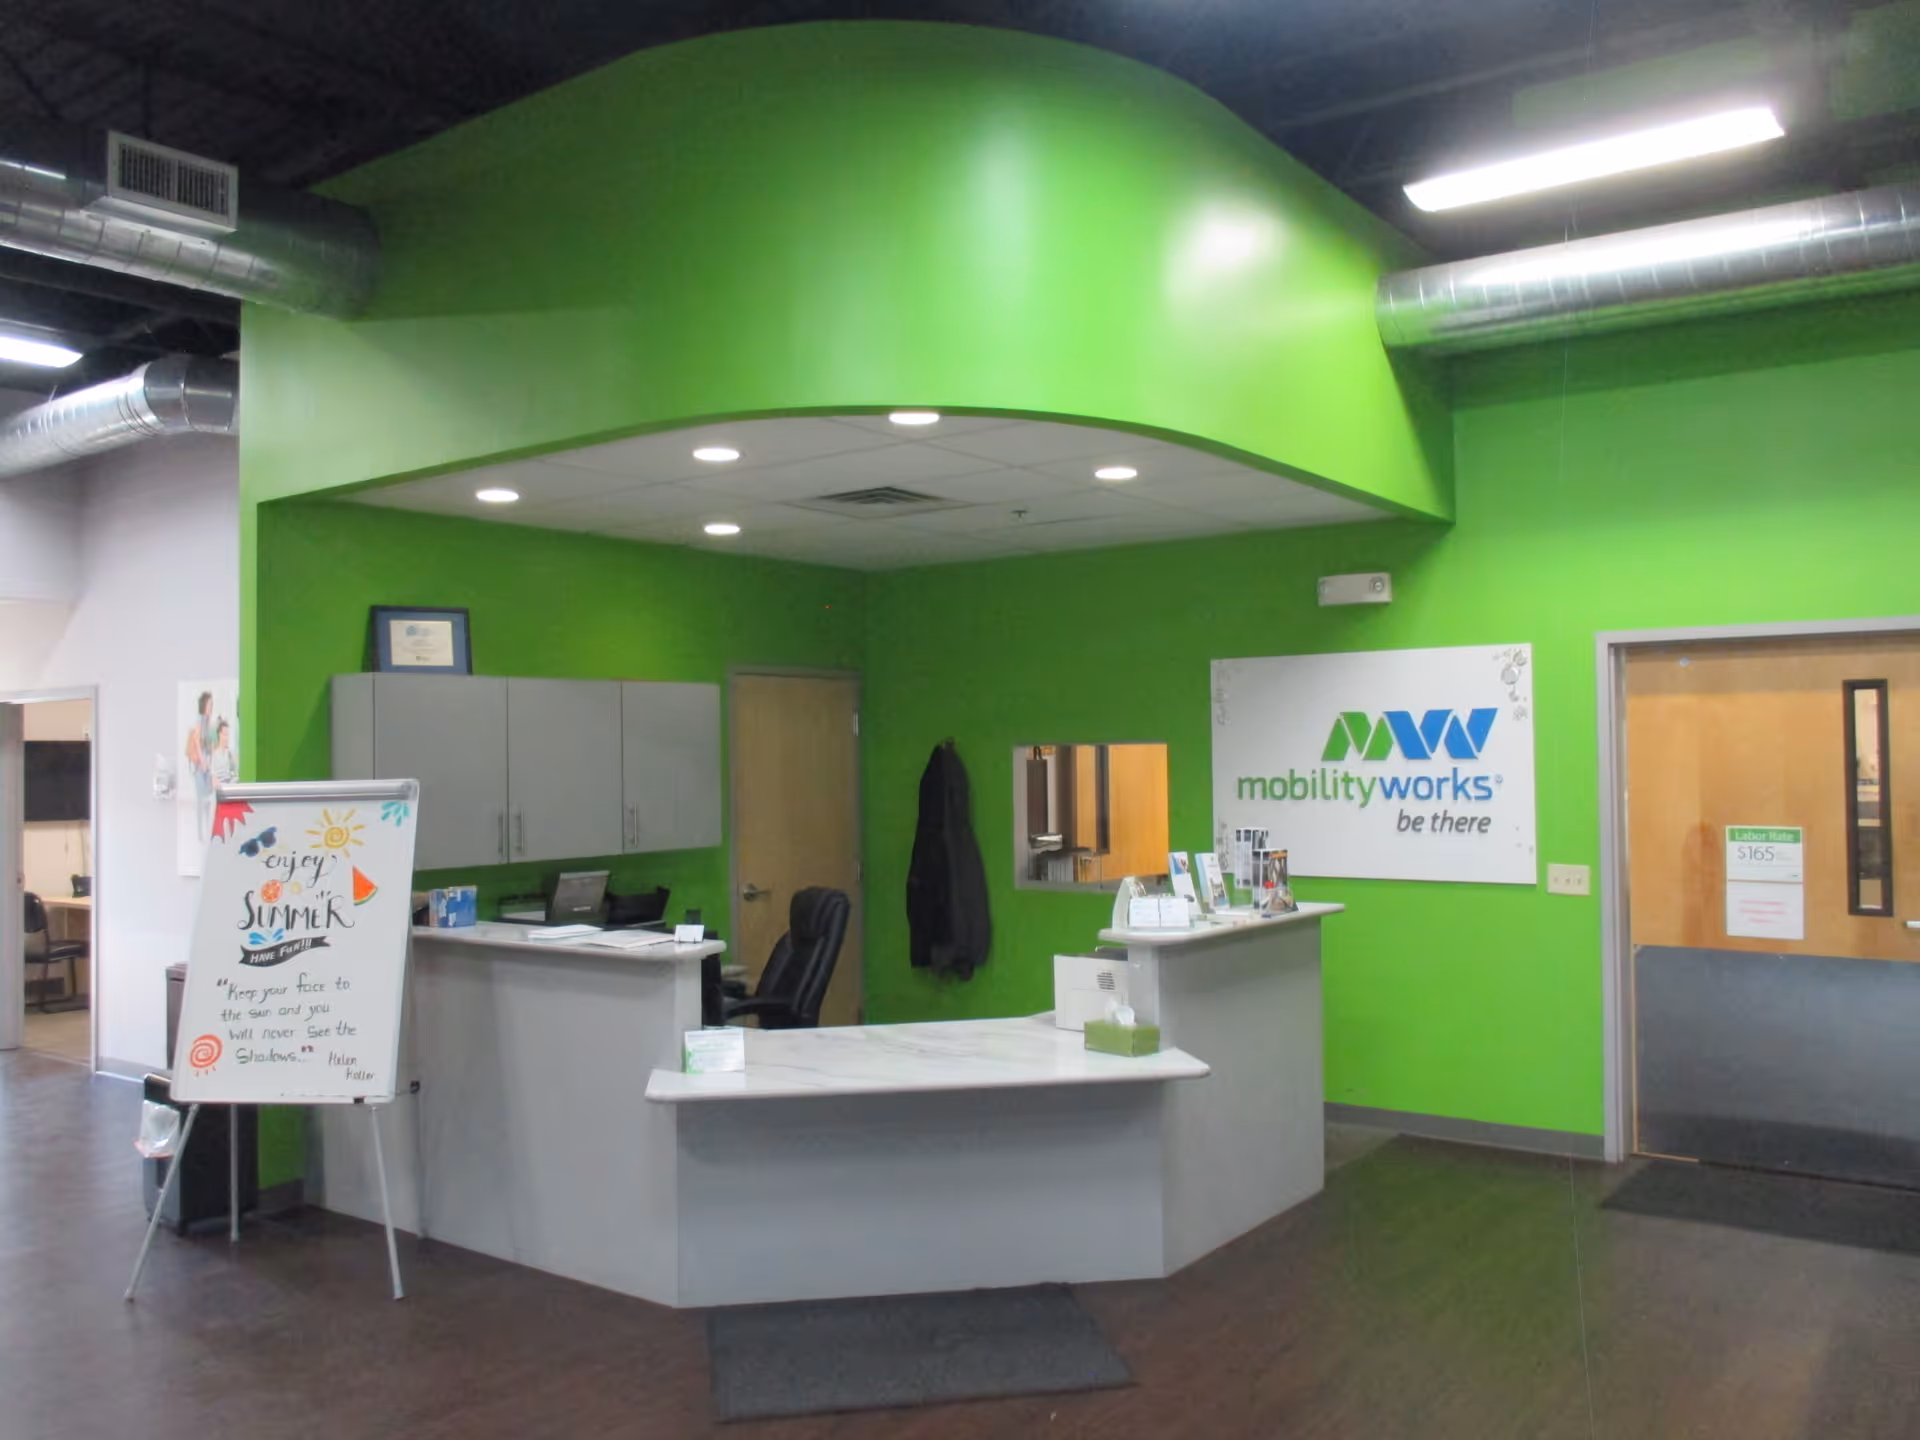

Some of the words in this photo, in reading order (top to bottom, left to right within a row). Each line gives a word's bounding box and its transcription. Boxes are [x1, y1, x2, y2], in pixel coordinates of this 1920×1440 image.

[1237, 767, 1494, 808] mobilityworks
[1396, 809, 1425, 833] be
[1431, 809, 1491, 833] there
[1735, 830, 1766, 841] Labor
[237, 890, 355, 930] SUMMER
[249, 951, 276, 964] HAVE
[258, 985, 288, 1004] your
[335, 976, 350, 991] to
[220, 1008, 242, 1022] the
[248, 1008, 271, 1019] sun
[278, 1004, 301, 1016] and
[304, 1003, 330, 1022] you
[262, 1028, 297, 1040] never
[336, 1020, 357, 1036] the
[328, 1050, 357, 1066] Helen
